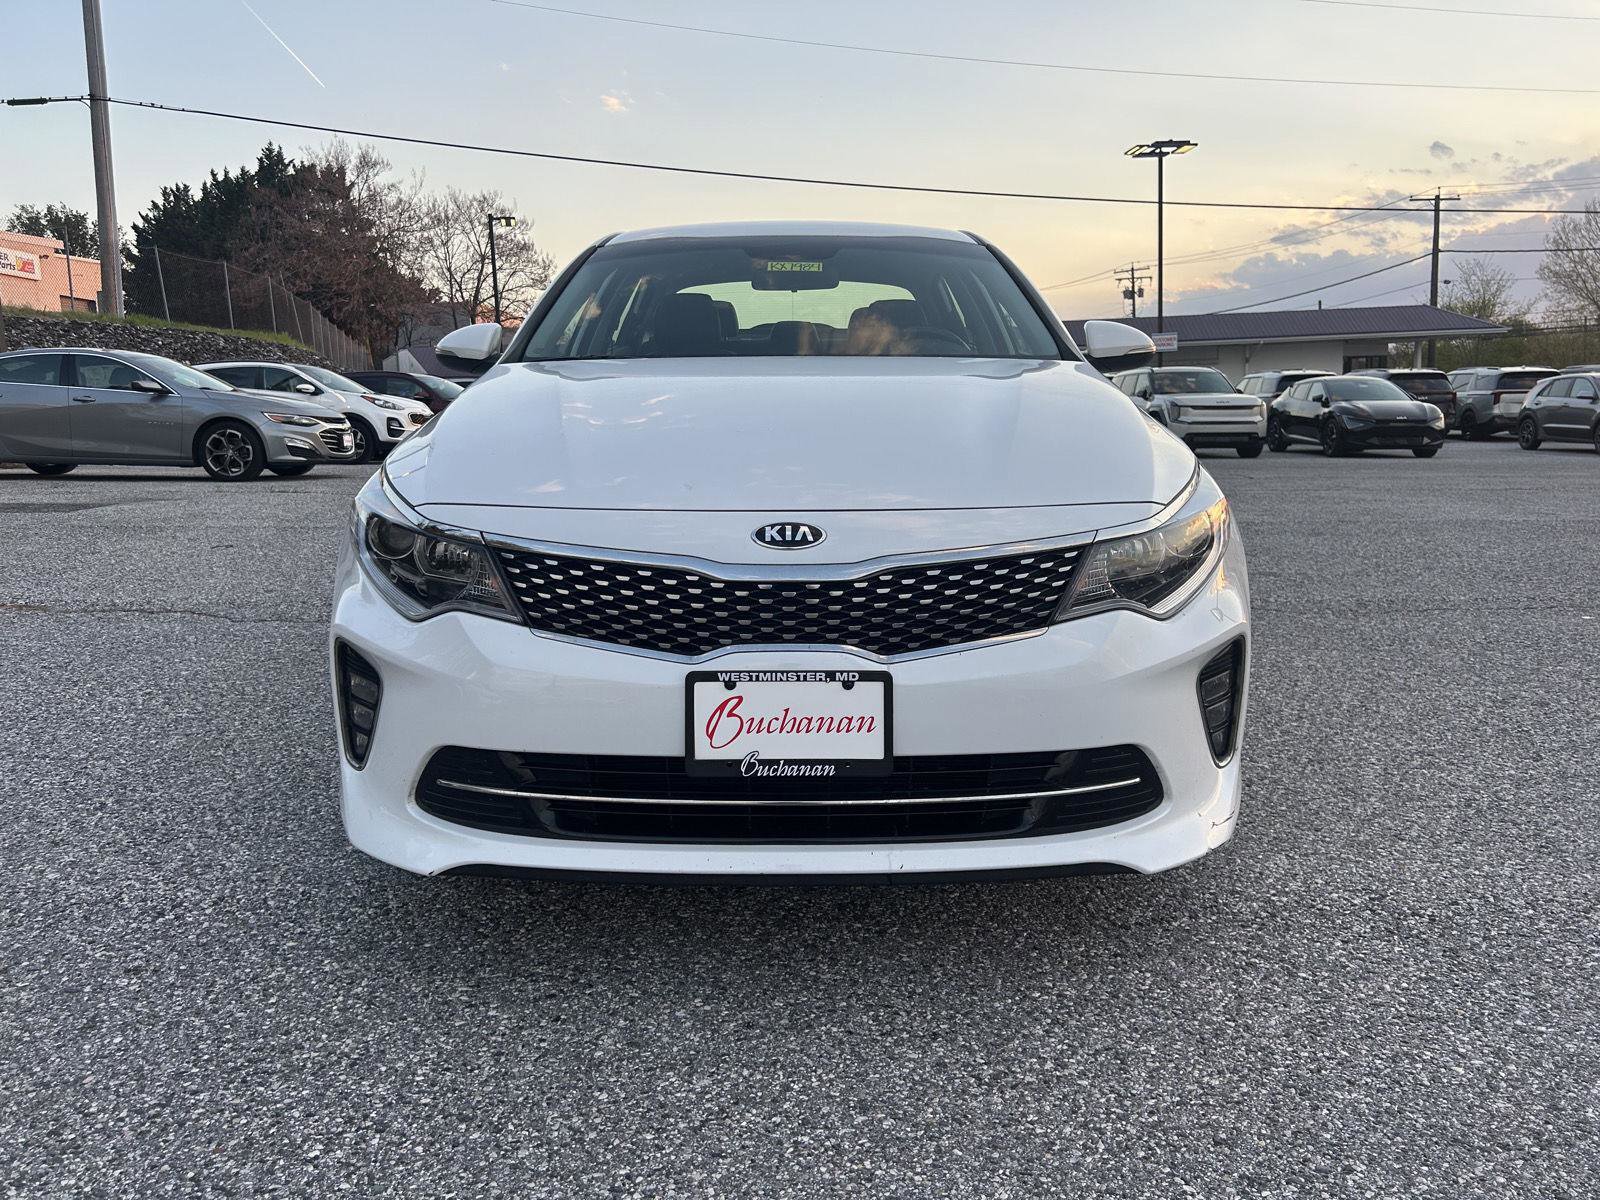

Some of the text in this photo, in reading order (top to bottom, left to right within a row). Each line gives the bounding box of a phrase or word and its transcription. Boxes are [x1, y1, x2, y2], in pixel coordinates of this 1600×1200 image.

[0, 261, 16, 271] arts
[764, 525, 814, 541] KIA
[717, 672, 860, 683] WESTMINSTER, MD
[705, 695, 877, 749] Buchanan
[740, 750, 836, 777] Buchanan
